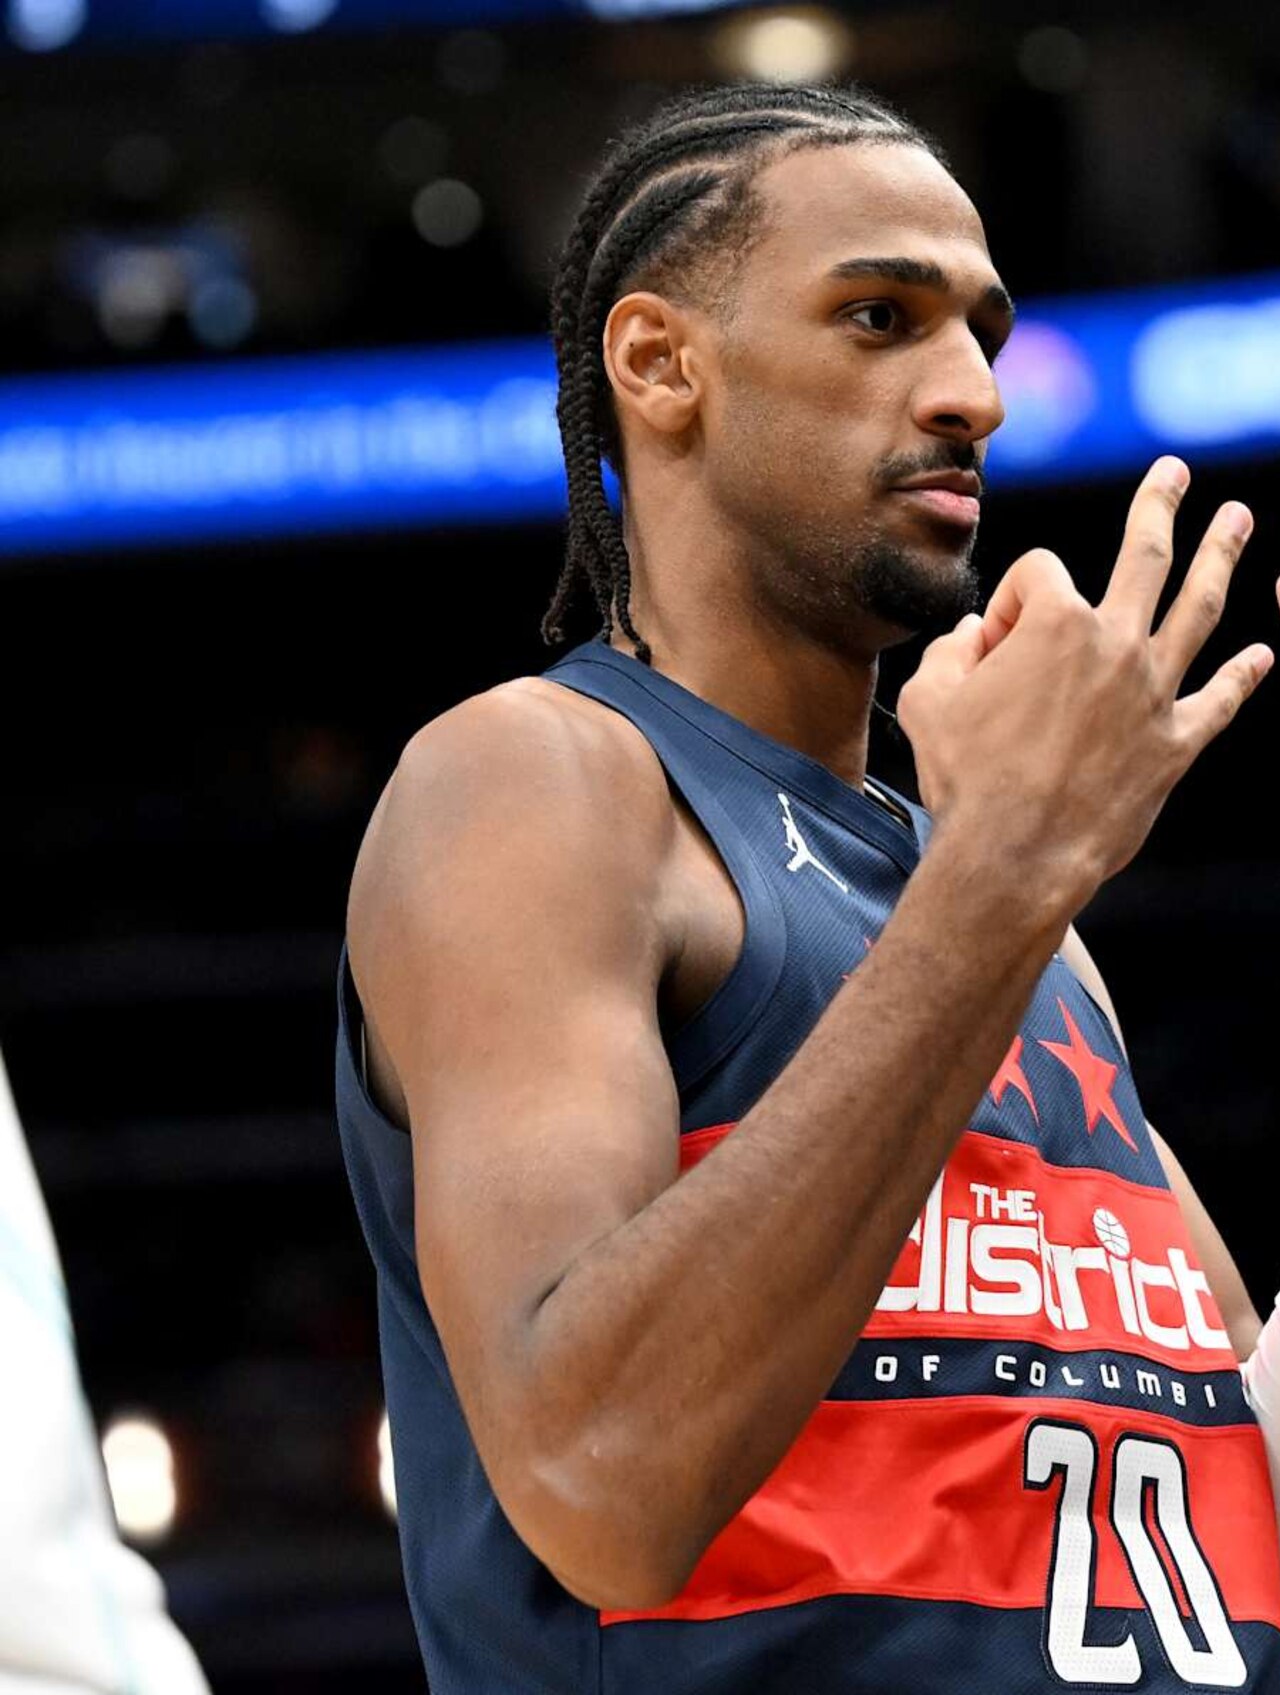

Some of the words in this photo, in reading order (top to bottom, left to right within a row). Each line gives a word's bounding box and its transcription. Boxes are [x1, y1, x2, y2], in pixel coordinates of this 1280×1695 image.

[970, 1183, 1038, 1221] THE
[875, 1355, 940, 1381] OF
[995, 1355, 1250, 1407] COLUMBI
[1024, 1417, 1249, 1689] 20
